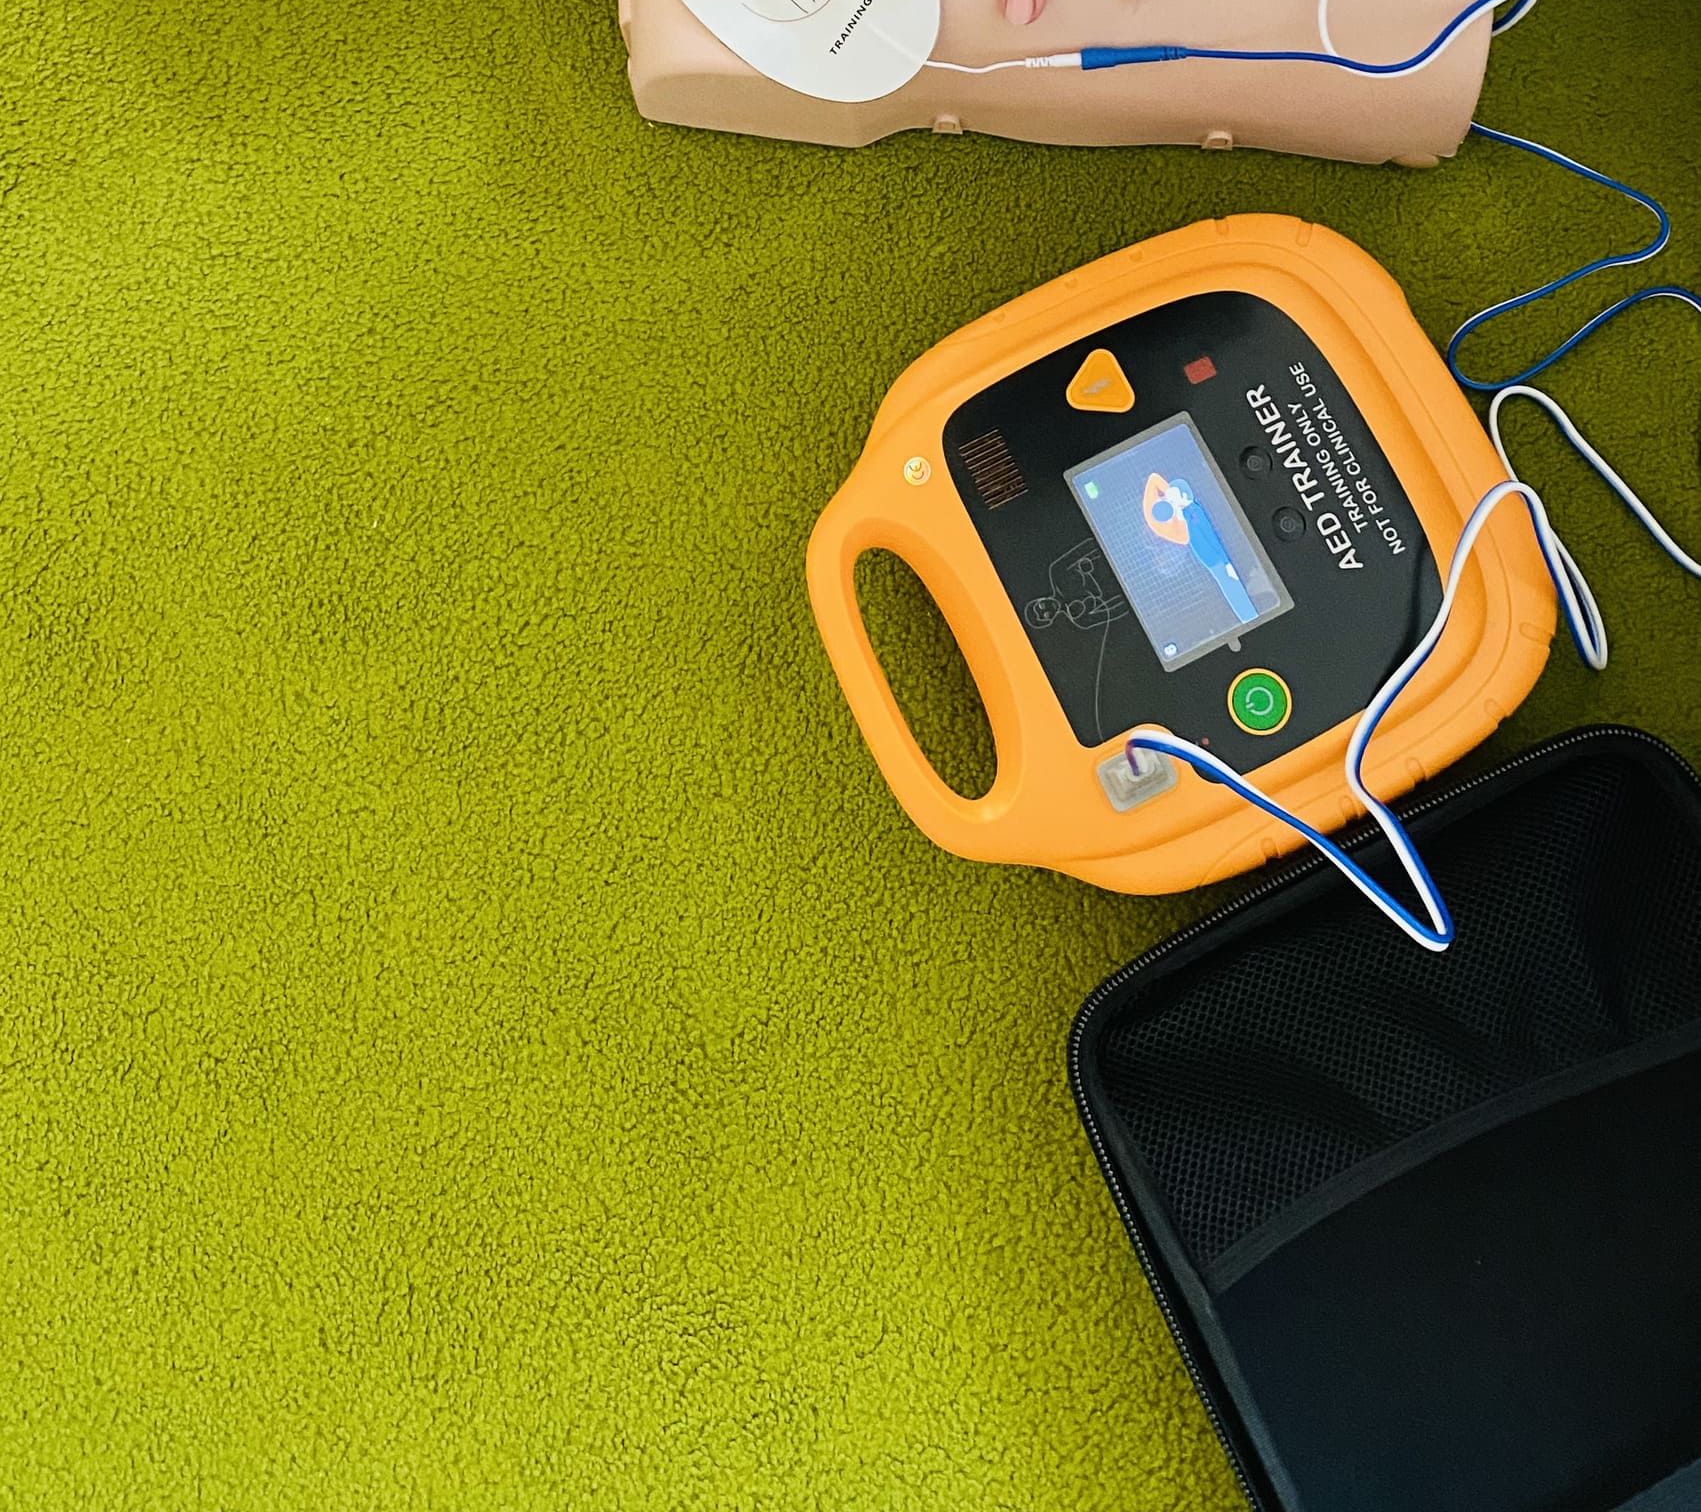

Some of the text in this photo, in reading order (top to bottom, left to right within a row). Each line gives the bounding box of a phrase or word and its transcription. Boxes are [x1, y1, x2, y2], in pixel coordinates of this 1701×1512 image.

[1246, 384, 1364, 570] AED TRAINER
[1287, 401, 1369, 534] TRAINING ONLY
[1288, 361, 1407, 555] NOT FOR CLINICAL USE
